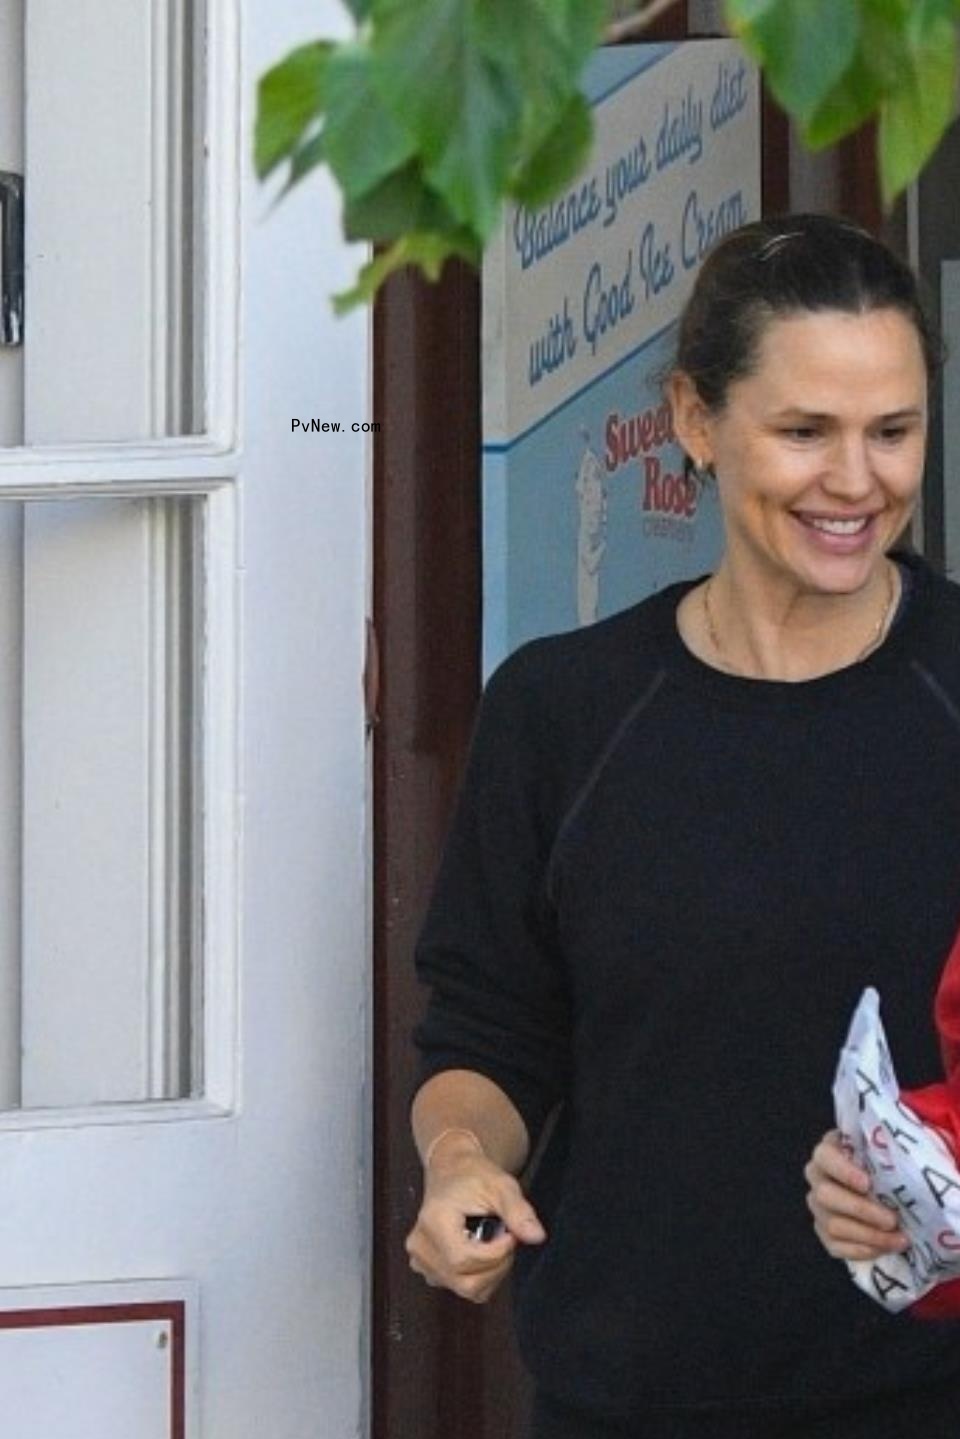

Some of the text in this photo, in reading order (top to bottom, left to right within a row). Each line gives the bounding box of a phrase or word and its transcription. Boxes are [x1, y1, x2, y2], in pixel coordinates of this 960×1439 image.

[513, 62, 747, 270] Balance your daily diet
[528, 189, 748, 386] with Good Ice Cream
[642, 456, 697, 518] Rose
